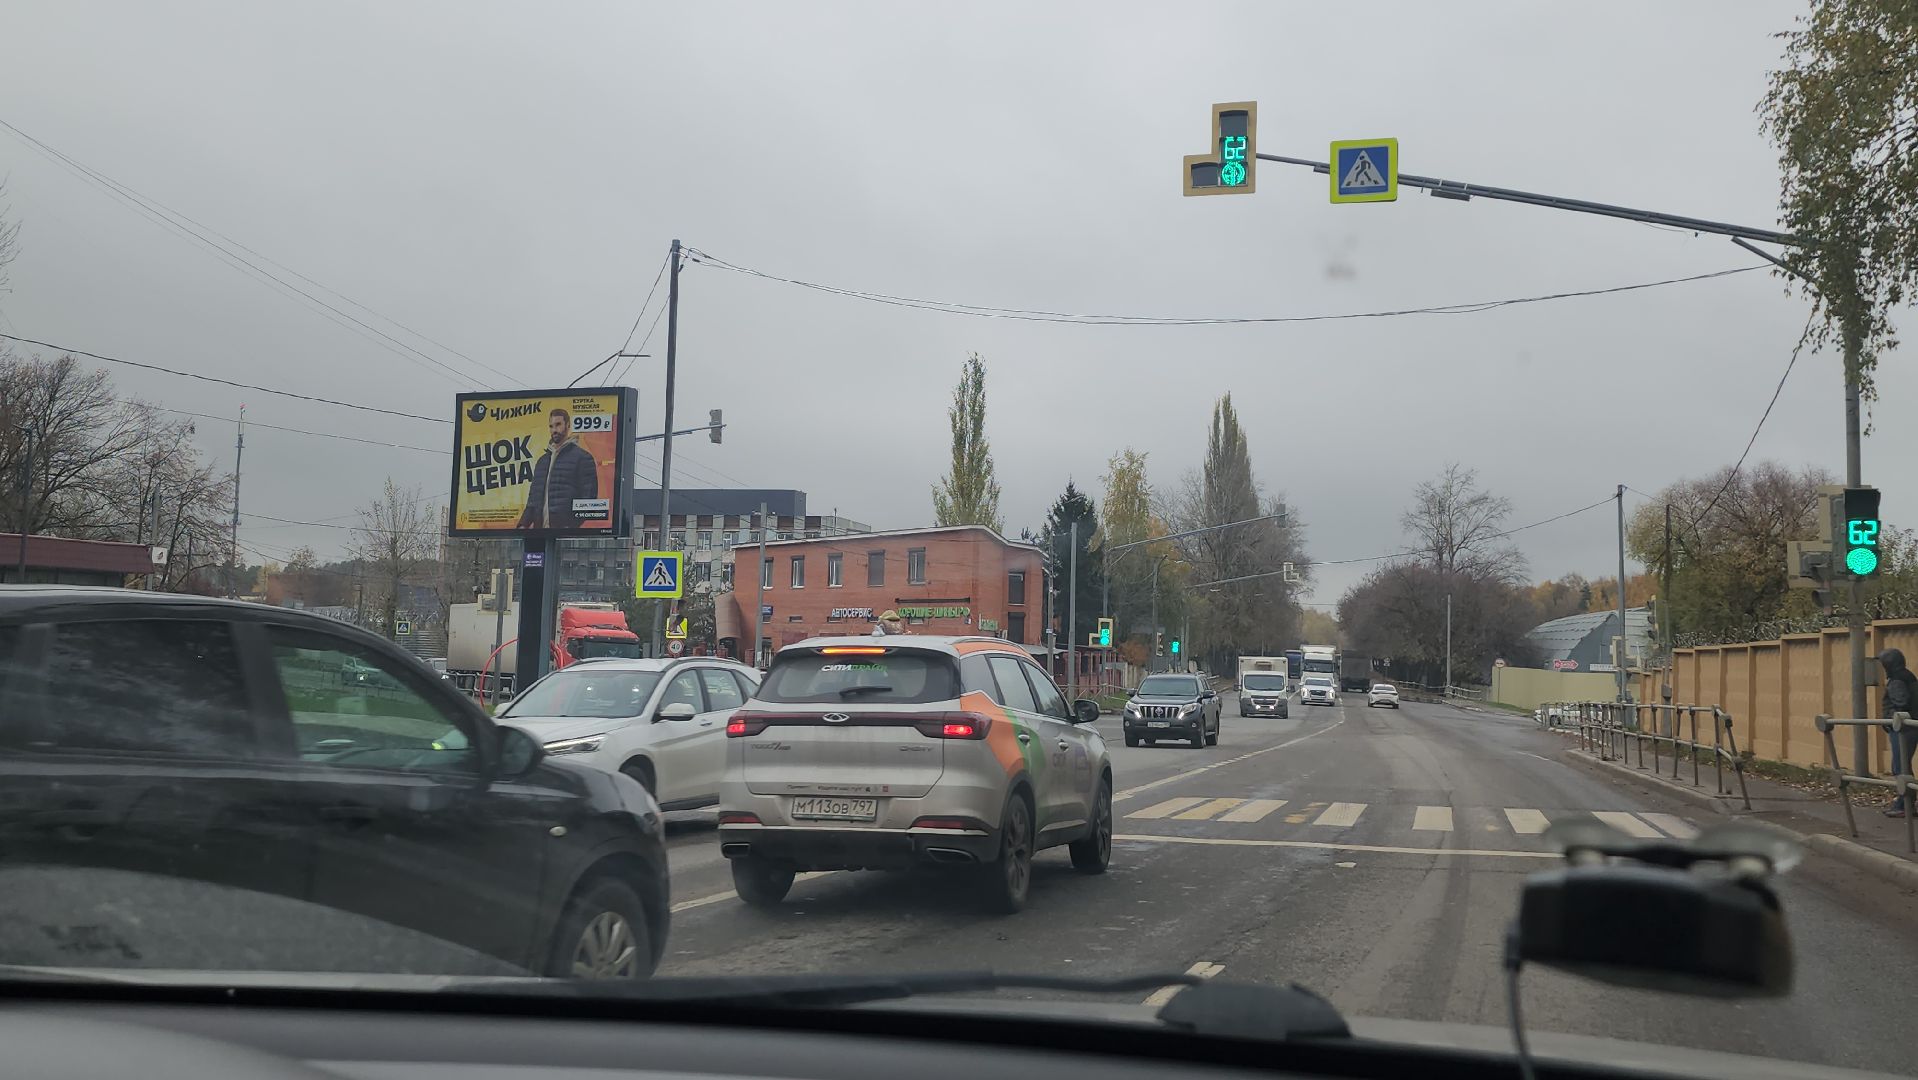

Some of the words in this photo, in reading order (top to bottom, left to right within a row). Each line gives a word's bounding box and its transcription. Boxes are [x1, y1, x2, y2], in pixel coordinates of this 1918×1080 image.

[1224, 136, 1246, 160] 62
[490, 401, 542, 421] ЧИЖИК
[573, 416, 602, 430] 999
[464, 434, 533, 470] ШОК
[465, 460, 533, 496] ЦЕНА
[1848, 520, 1878, 545] 62
[831, 607, 872, 618] АВТОСЕРВИС
